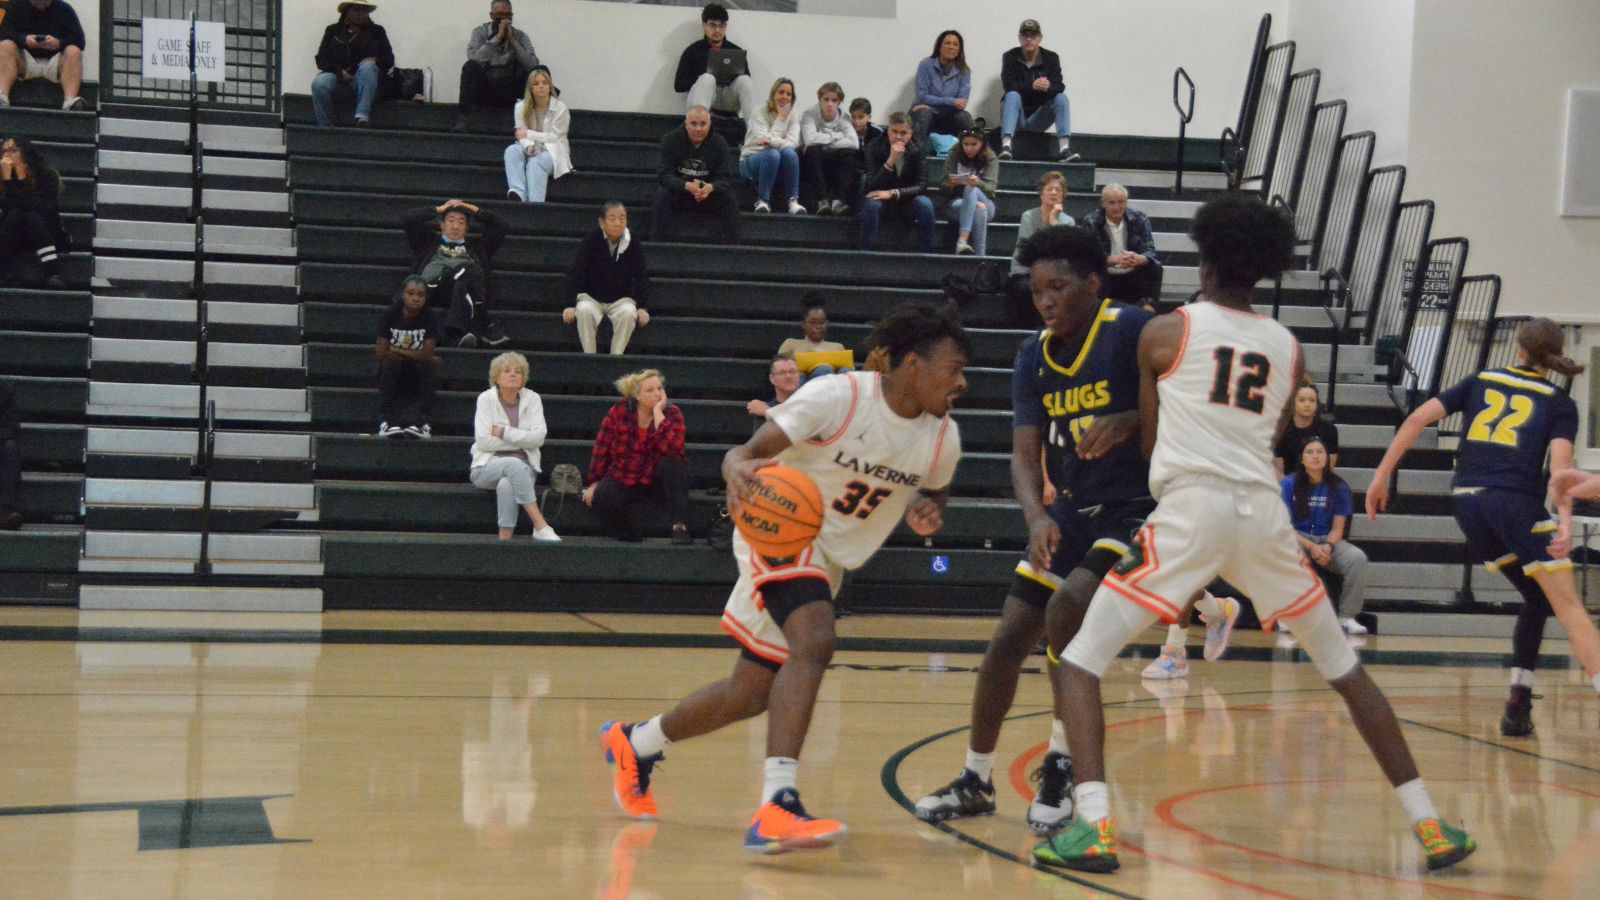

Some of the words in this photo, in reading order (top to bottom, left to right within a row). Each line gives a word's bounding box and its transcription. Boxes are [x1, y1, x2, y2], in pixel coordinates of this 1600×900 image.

[151, 53, 158, 66] &
[162, 53, 190, 68] MEDIA
[157, 38, 182, 52] GAME
[186, 40, 211, 54] SAFF
[1041, 379, 1111, 417] SLUGS
[1206, 345, 1270, 415] 12
[1466, 388, 1533, 446] 22
[833, 450, 858, 472] LA
[864, 460, 921, 486] VERNE
[831, 478, 894, 520] 35
[741, 510, 780, 535] NCAA
